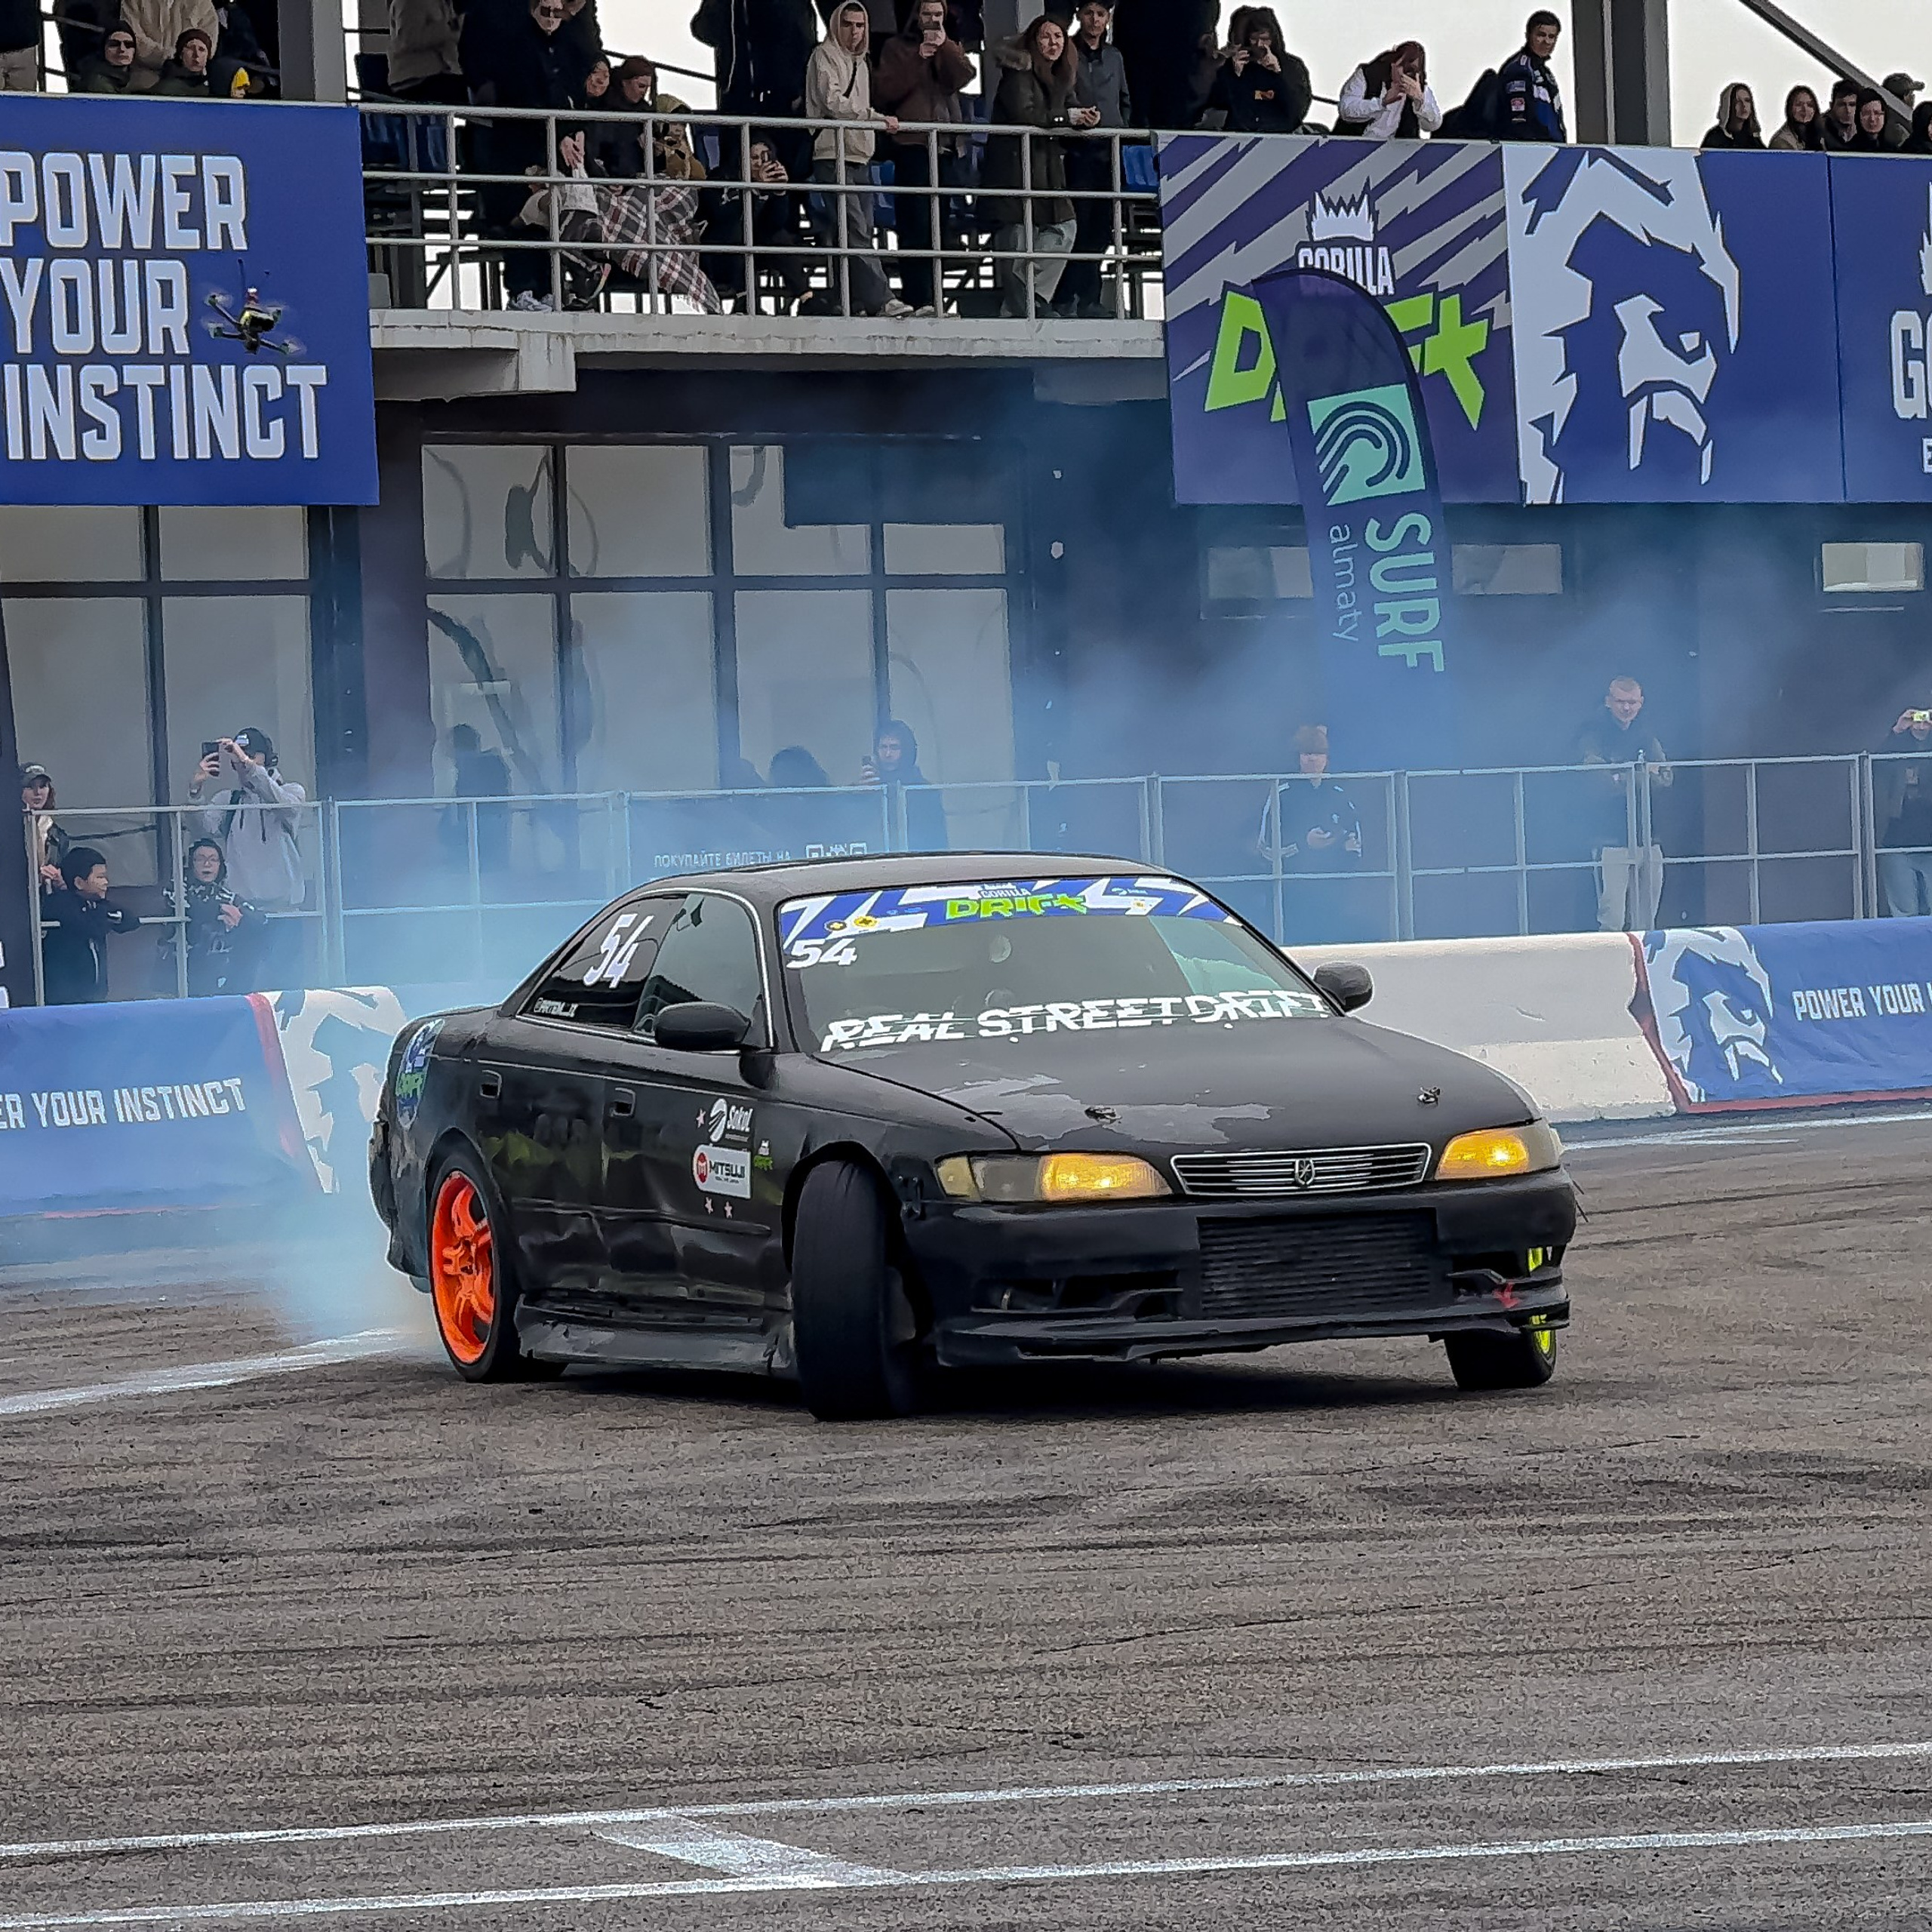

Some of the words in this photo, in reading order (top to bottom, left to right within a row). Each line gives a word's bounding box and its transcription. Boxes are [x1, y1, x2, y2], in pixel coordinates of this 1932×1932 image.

[0, 152, 248, 251] POWER
[0, 257, 191, 355] YOUR
[2, 363, 328, 460] INSTINCT
[1329, 523, 1363, 641] almaty
[1364, 512, 1445, 672] SURF
[654, 848, 721, 868] ПОКУПАЙТЕ
[980, 888, 1032, 898] GORILLA
[583, 913, 655, 989] 54
[786, 938, 858, 969] 54
[820, 1011, 977, 1053] REAL
[1792, 986, 1868, 1021] POWER
[1867, 983, 1926, 1017] YOUR
[30, 1090, 107, 1128] YOUR
[113, 1077, 246, 1124] INSTINCT
